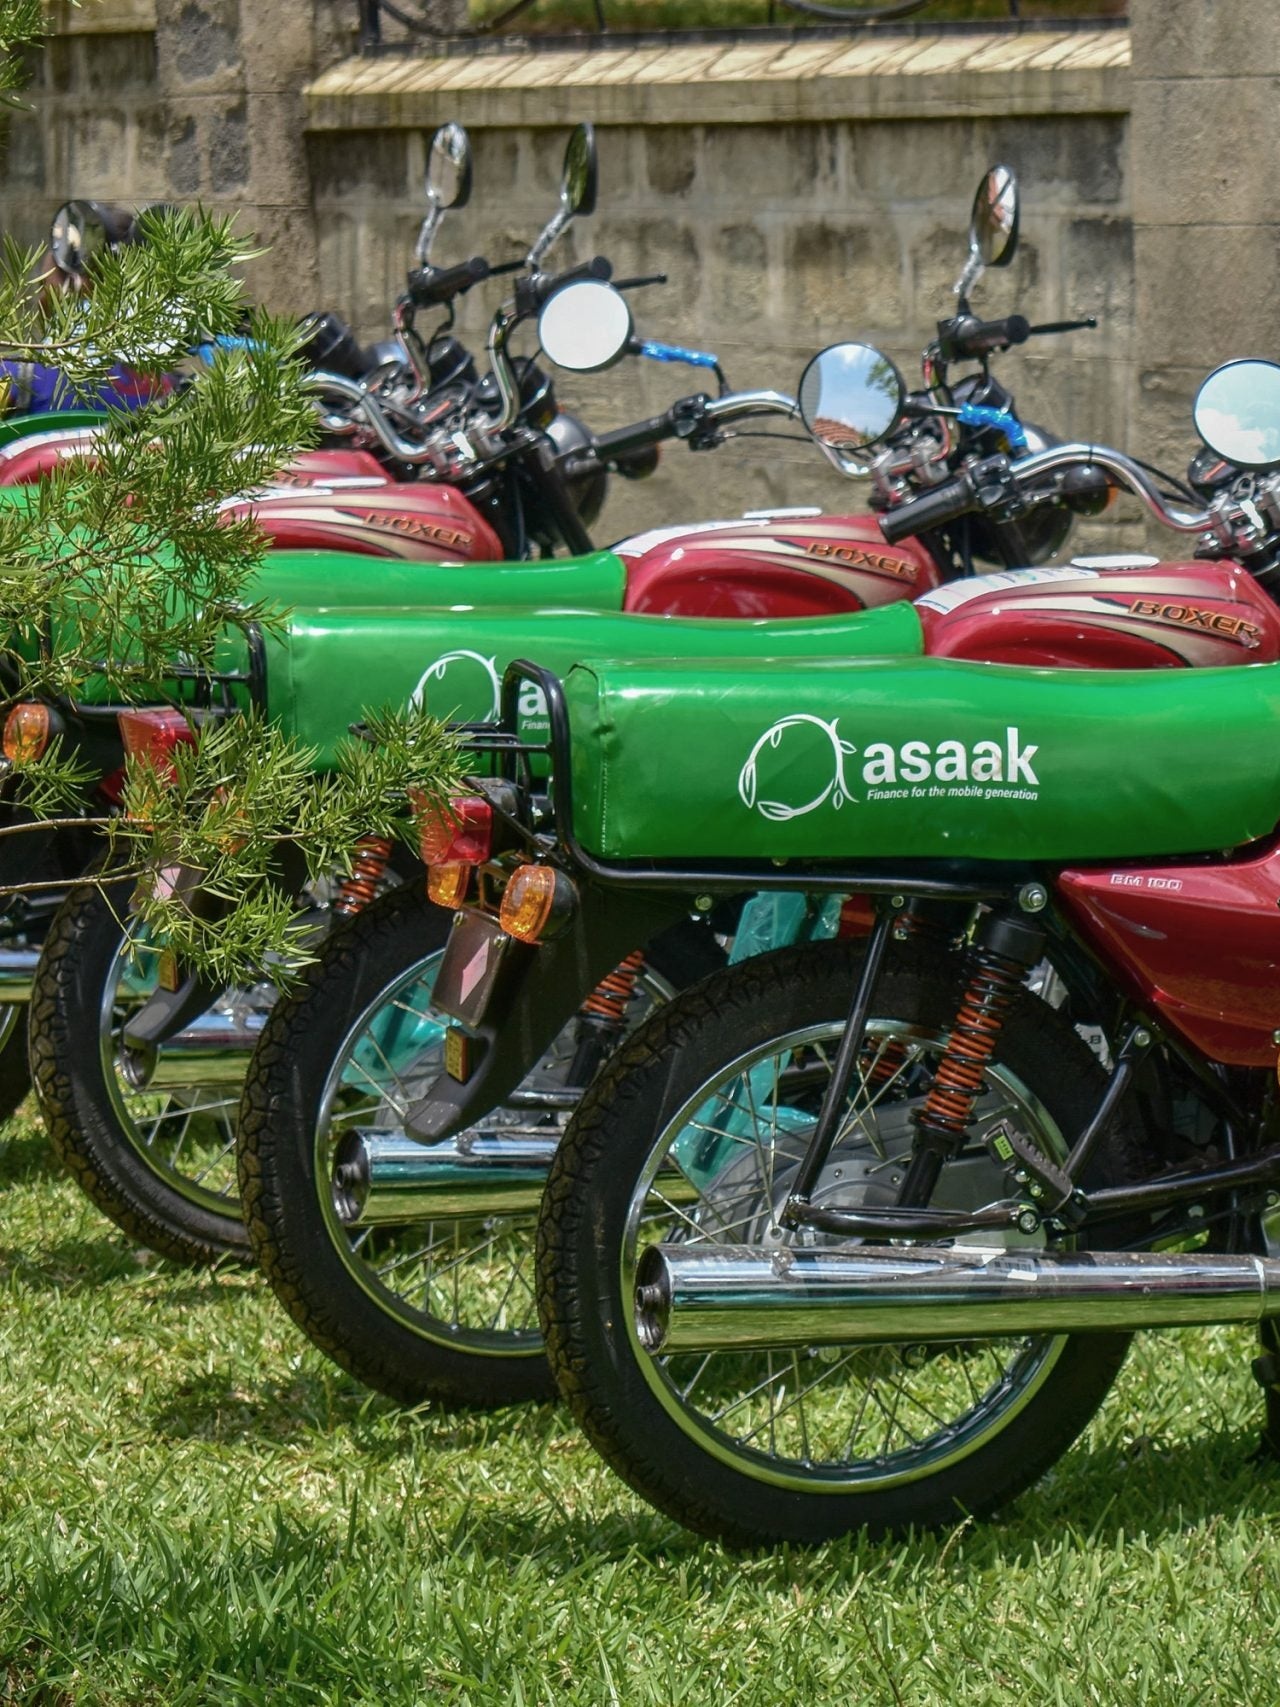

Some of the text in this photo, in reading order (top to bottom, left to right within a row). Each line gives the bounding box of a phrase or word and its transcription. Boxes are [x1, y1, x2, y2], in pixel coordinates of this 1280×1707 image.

[363, 512, 473, 545] BOXER
[805, 542, 919, 577] BOXER
[1128, 599, 1260, 641] BOXER
[862, 726, 1040, 785] asaak
[867, 785, 1038, 800] Finance for the mobile generation
